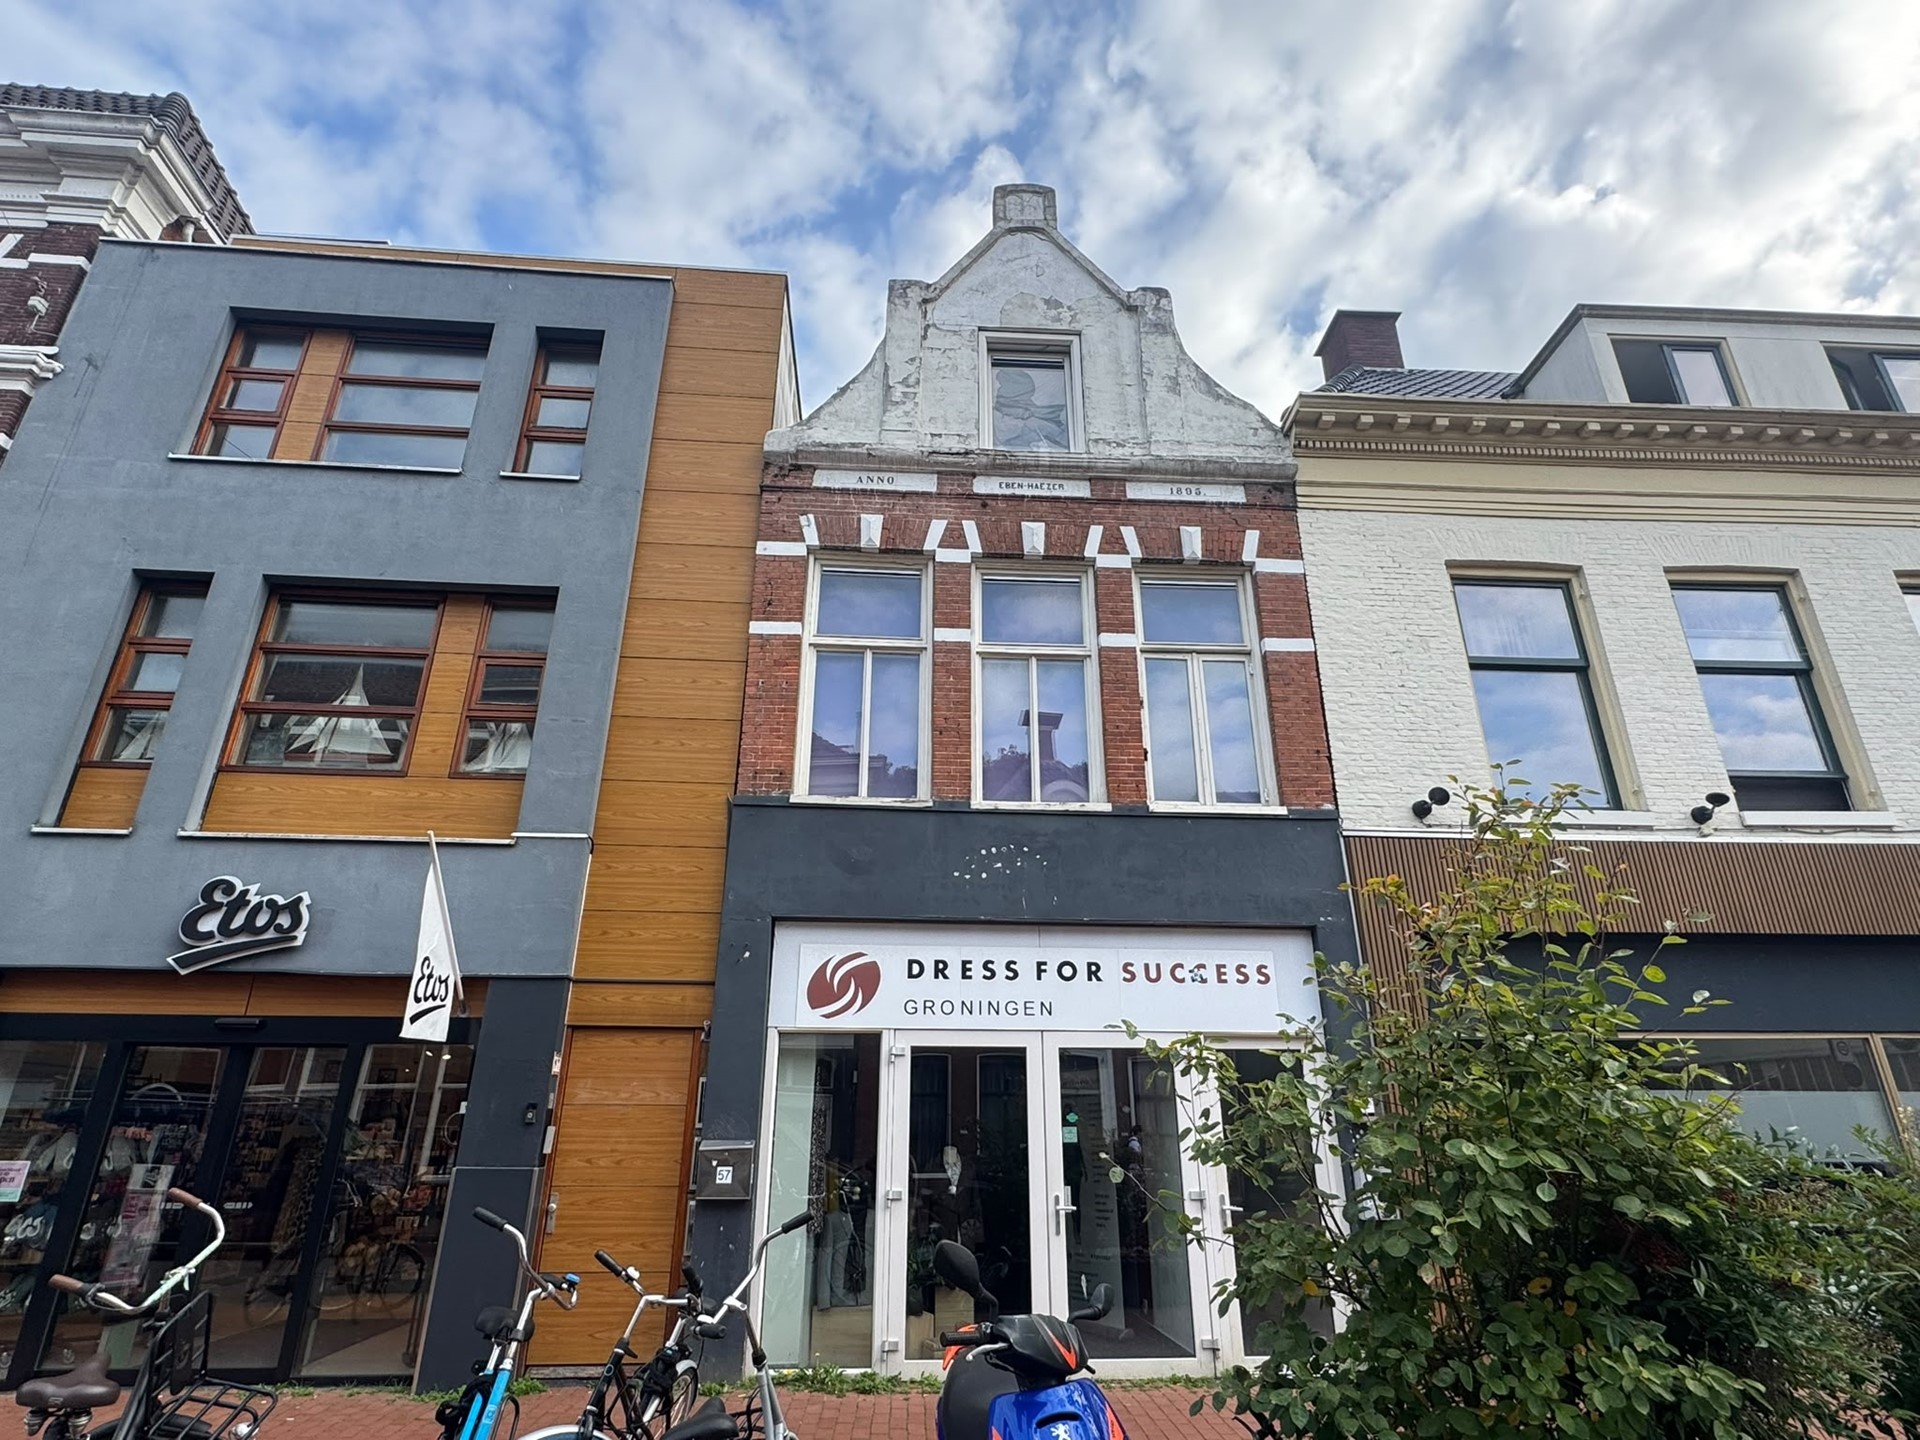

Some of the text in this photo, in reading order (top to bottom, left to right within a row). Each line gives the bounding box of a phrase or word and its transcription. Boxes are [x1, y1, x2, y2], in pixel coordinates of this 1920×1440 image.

[856, 475, 895, 485] ANNO
[998, 481, 1065, 491] EBEN-HAEZER
[179, 877, 306, 944] Etos
[413, 955, 450, 1004] Etos
[906, 958, 1272, 986] DRESS FOR SUCCESS
[903, 998, 1053, 1017] GRONINGEN
[717, 1169, 732, 1181] 57
